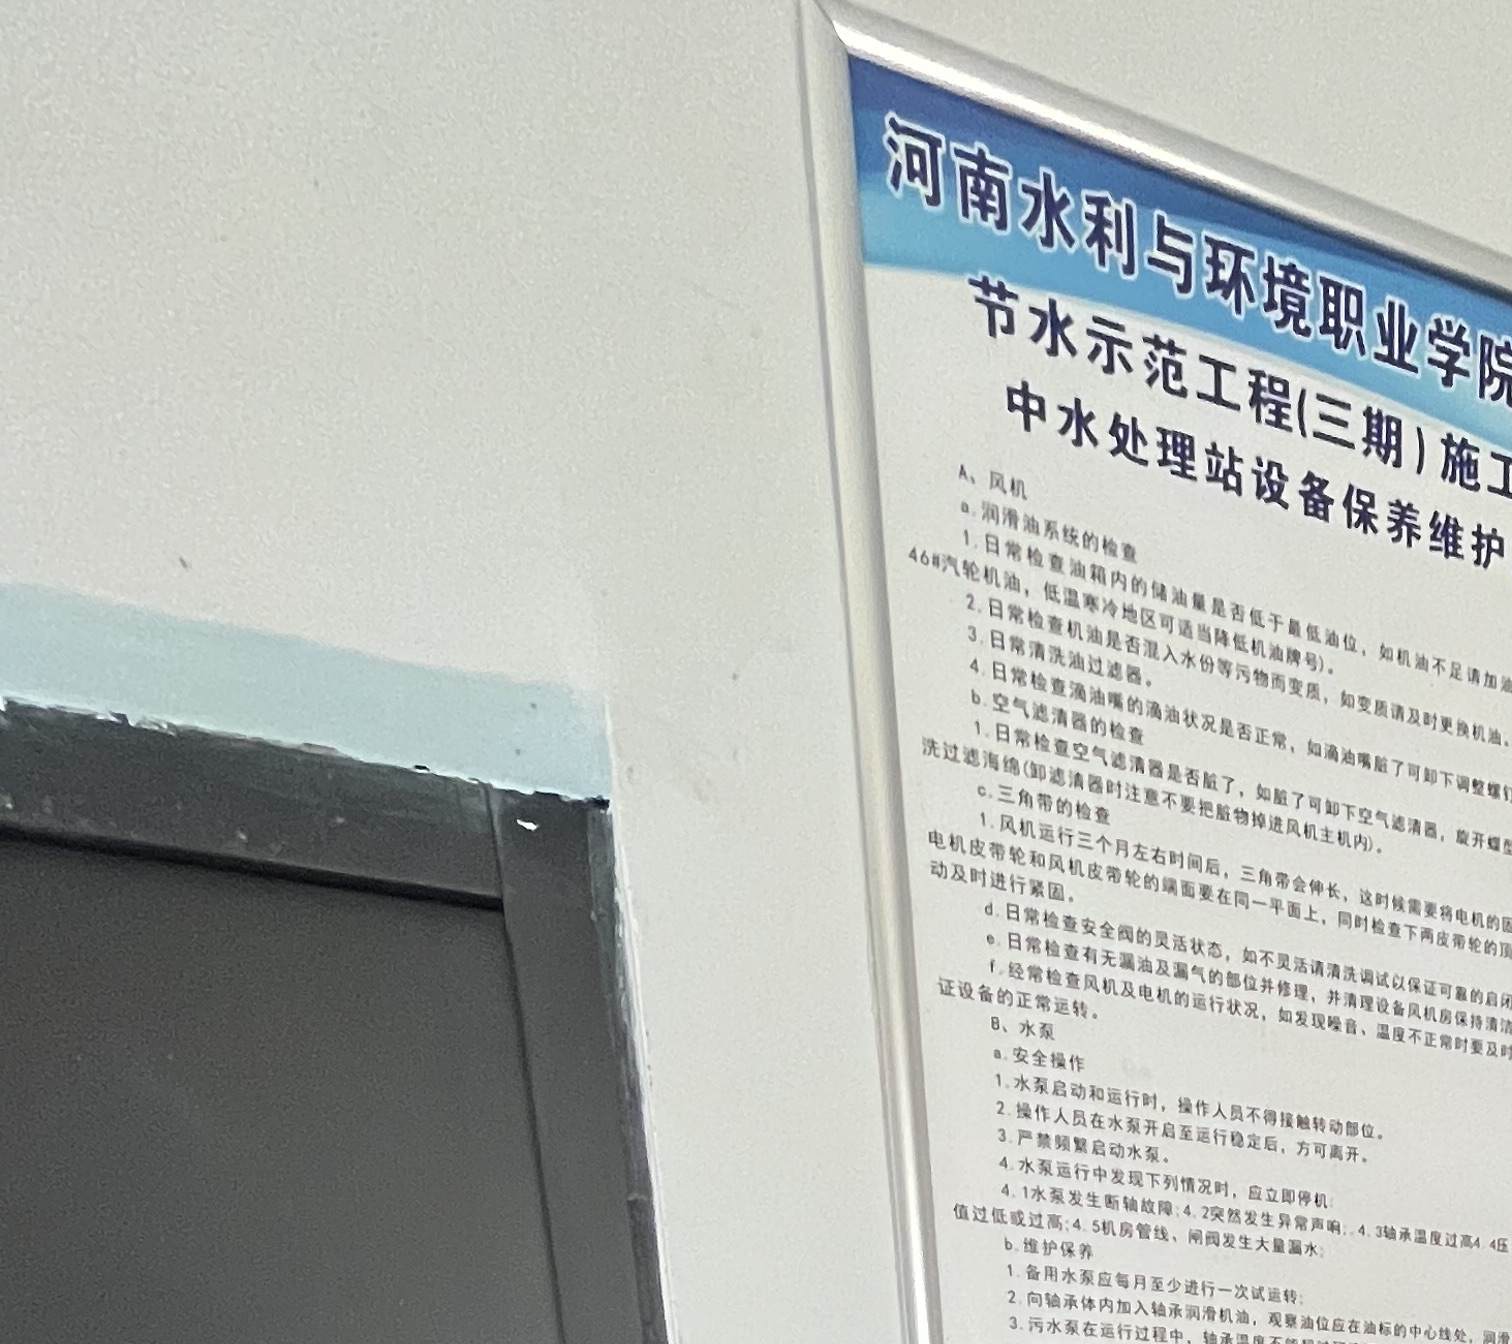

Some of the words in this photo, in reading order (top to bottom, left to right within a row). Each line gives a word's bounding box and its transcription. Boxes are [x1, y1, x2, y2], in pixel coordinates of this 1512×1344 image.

[957, 462, 1028, 502] A、风机
[976, 782, 1111, 827] c.三角带的检查
[928, 858, 1074, 903] 动及时进行紧固。
[935, 975, 1098, 1020] 证设备的正常运转。
[989, 1015, 1056, 1041] B、水泵
[992, 1044, 1086, 1073] a.安全操作
[1002, 1235, 1094, 1261] b.维护保养
